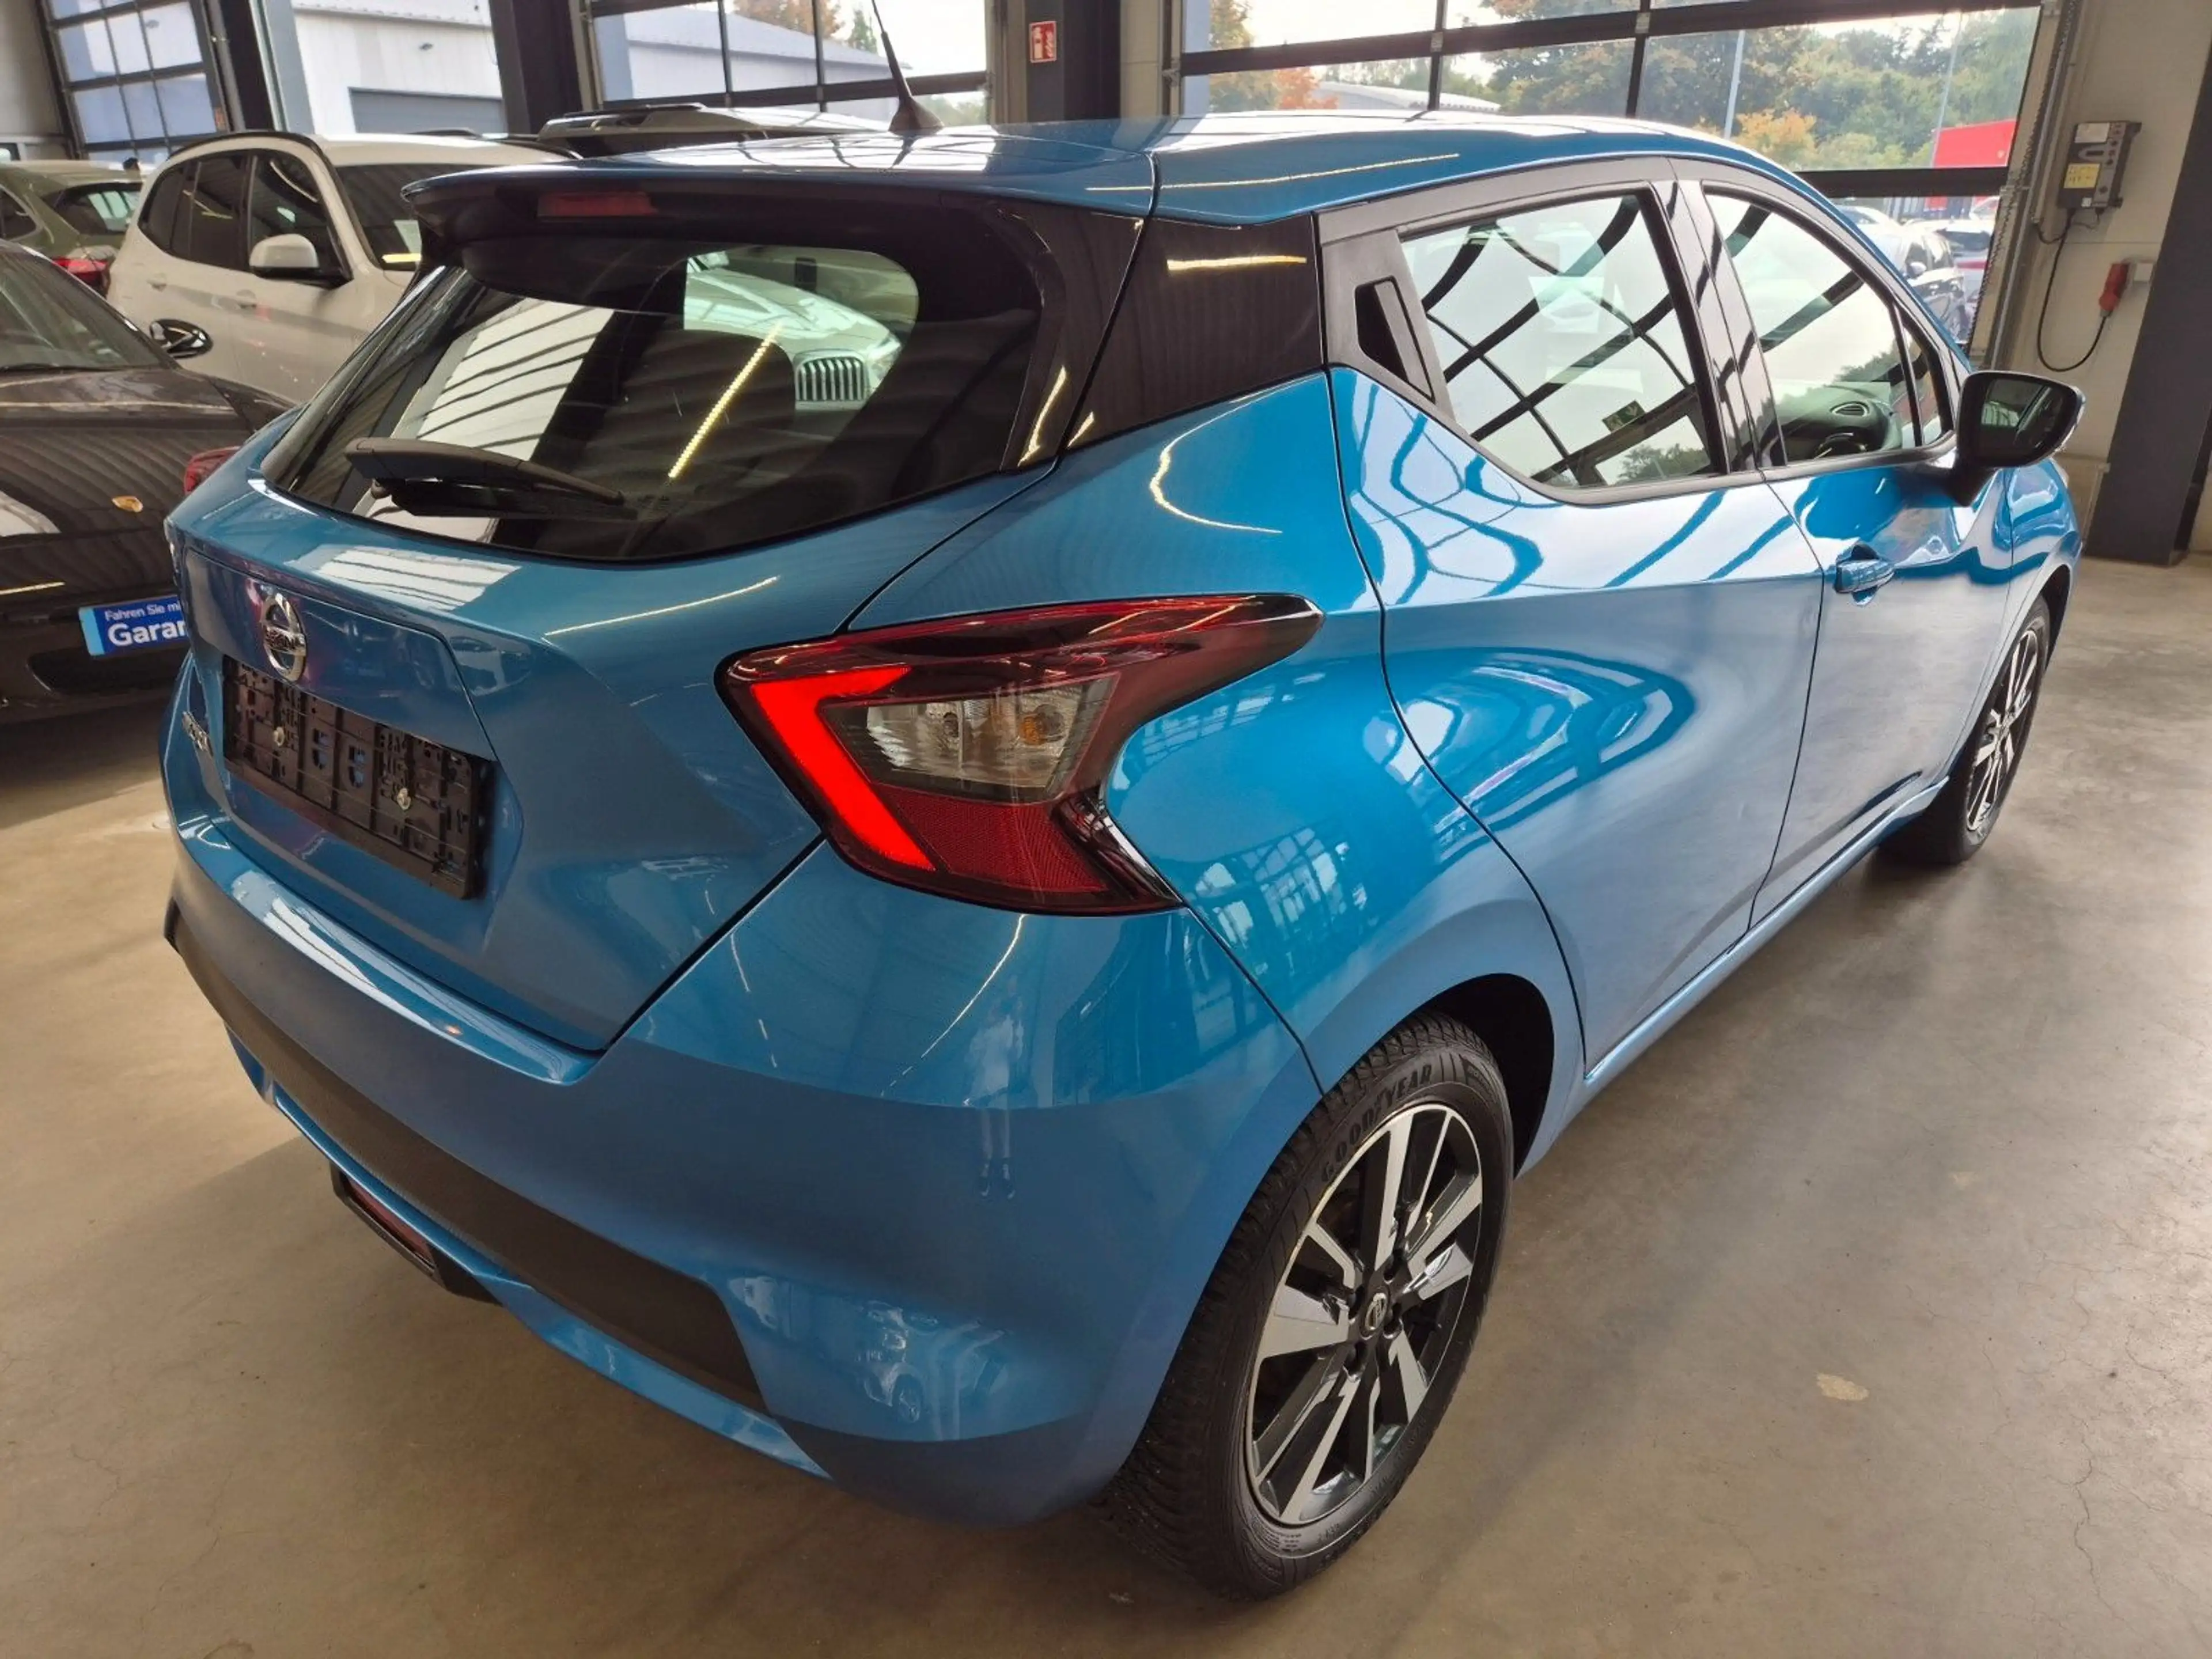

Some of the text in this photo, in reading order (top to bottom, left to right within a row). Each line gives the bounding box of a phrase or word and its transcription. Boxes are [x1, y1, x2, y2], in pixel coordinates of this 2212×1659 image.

[104, 608, 145, 621] Fahren
[146, 604, 165, 615] Sie
[1321, 1065, 1432, 1181] GOODYEAR
